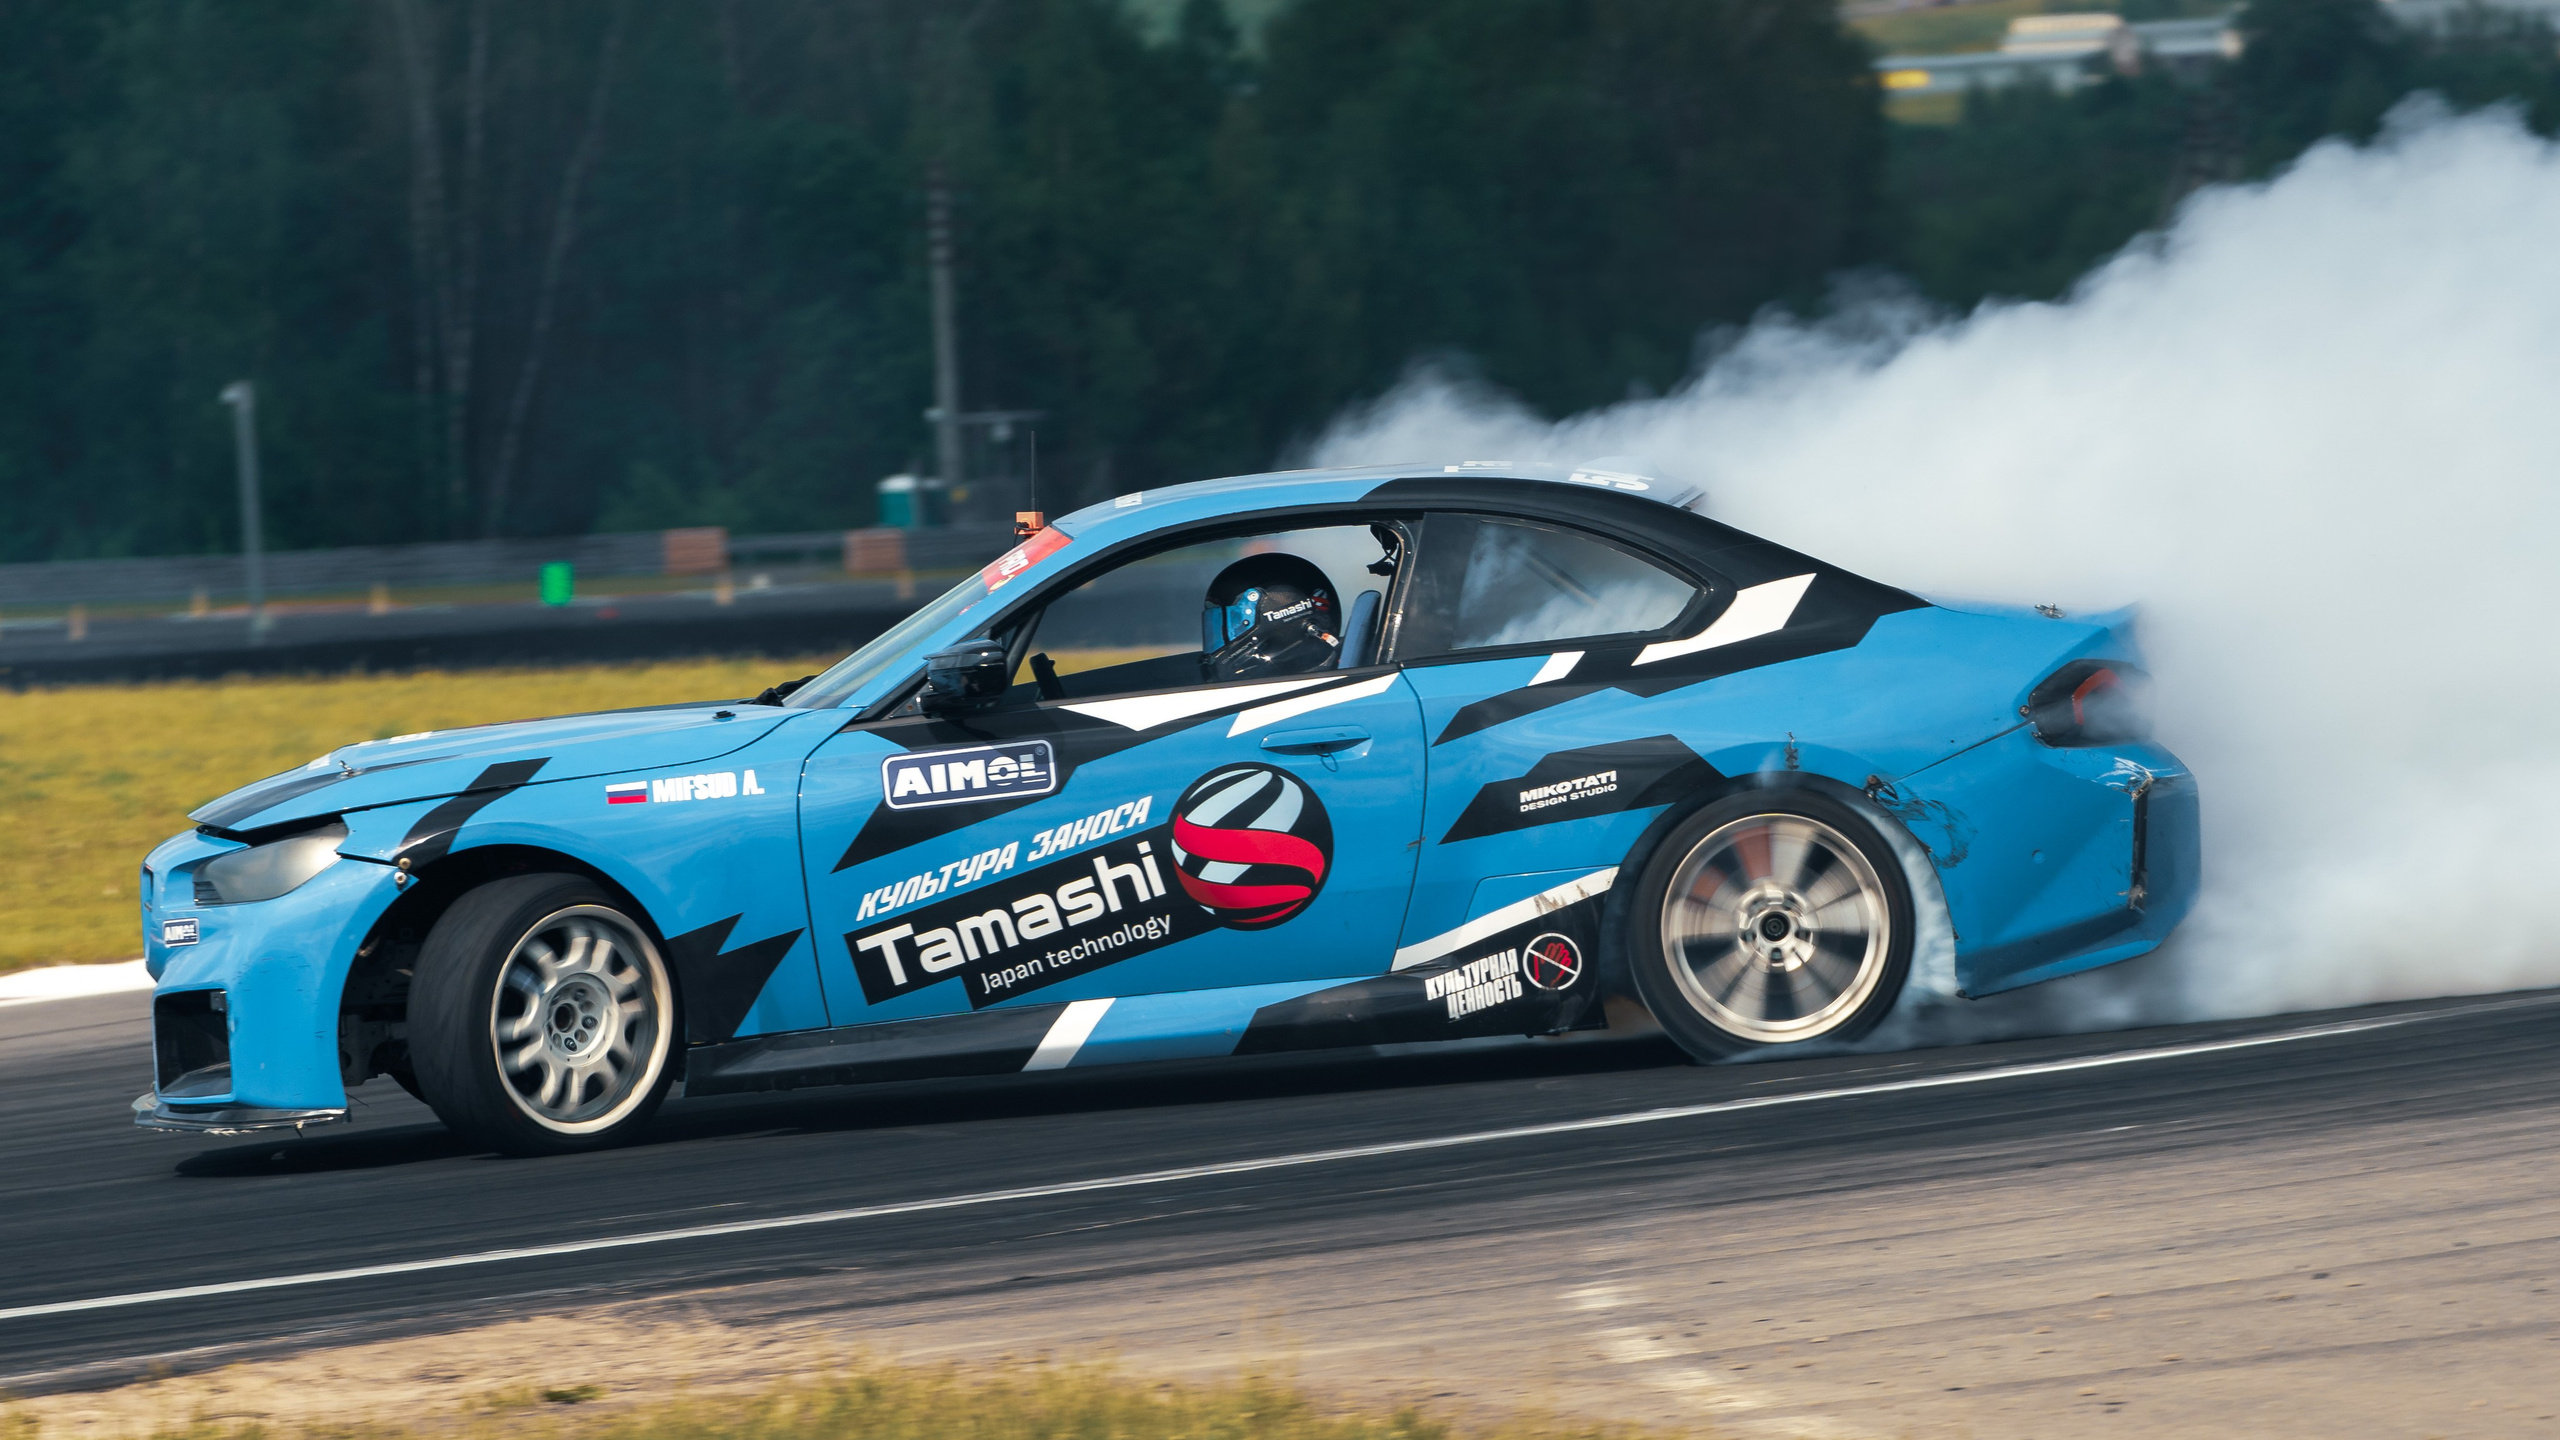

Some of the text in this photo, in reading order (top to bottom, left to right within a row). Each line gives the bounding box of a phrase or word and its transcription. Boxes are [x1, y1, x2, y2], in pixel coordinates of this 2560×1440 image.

[1263, 598, 1312, 621] Tamashi
[652, 769, 765, 803] MIFSUD A.
[893, 754, 1047, 797] AIMOL
[1520, 770, 1617, 803] MIKOTATI
[1520, 784, 1617, 812] DESIGN STUDIO
[856, 795, 1153, 922] КУЛЬТУРА ЗАНОСА
[856, 841, 1167, 986] Tamashi
[981, 914, 1171, 993] Japan technology
[1425, 948, 1519, 1000] КУЛЬТУРНАЯ
[1446, 974, 1523, 1019] ЦЕННОСТЬ
